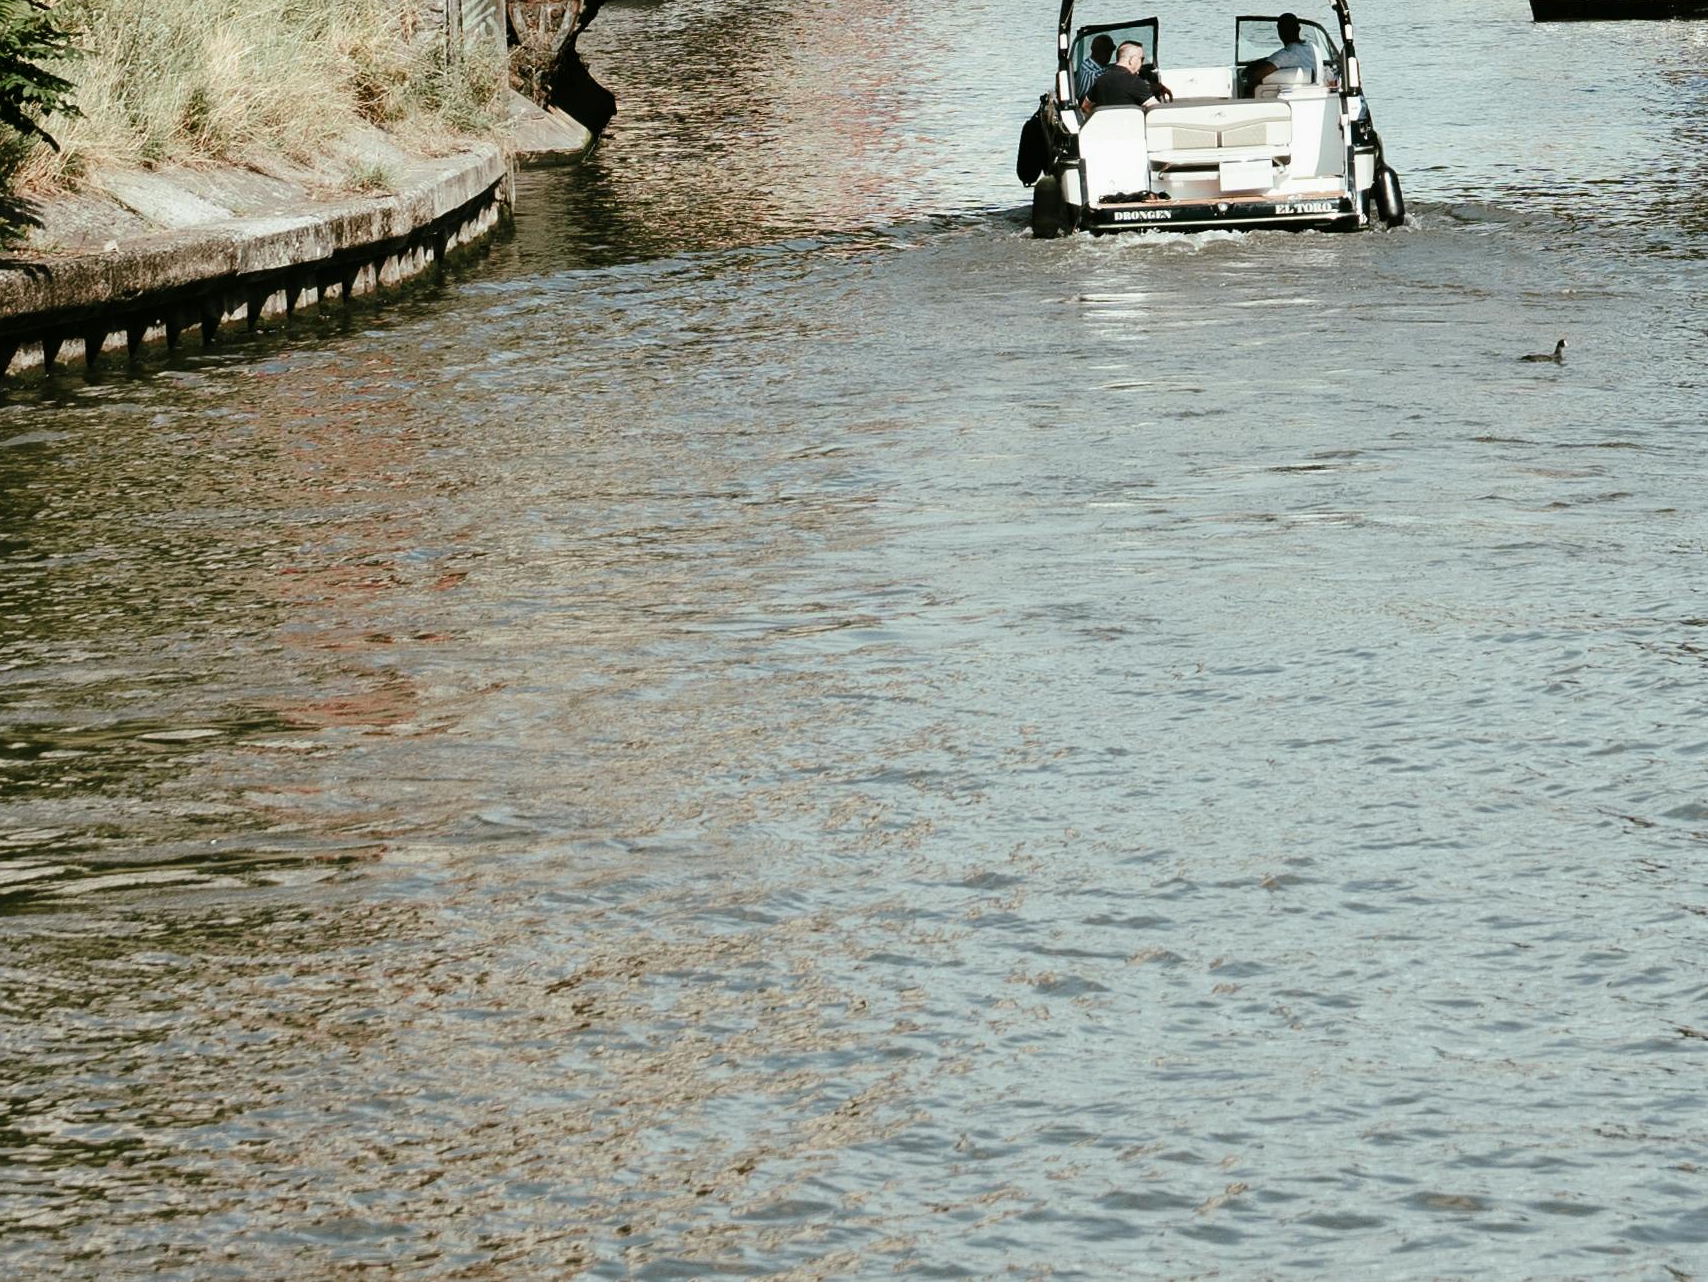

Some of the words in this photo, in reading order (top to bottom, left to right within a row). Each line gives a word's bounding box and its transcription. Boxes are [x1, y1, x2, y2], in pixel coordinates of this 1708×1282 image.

[1275, 204, 1294, 214] EL
[1294, 202, 1332, 213] TORO
[1114, 209, 1172, 221] DRONGEN
